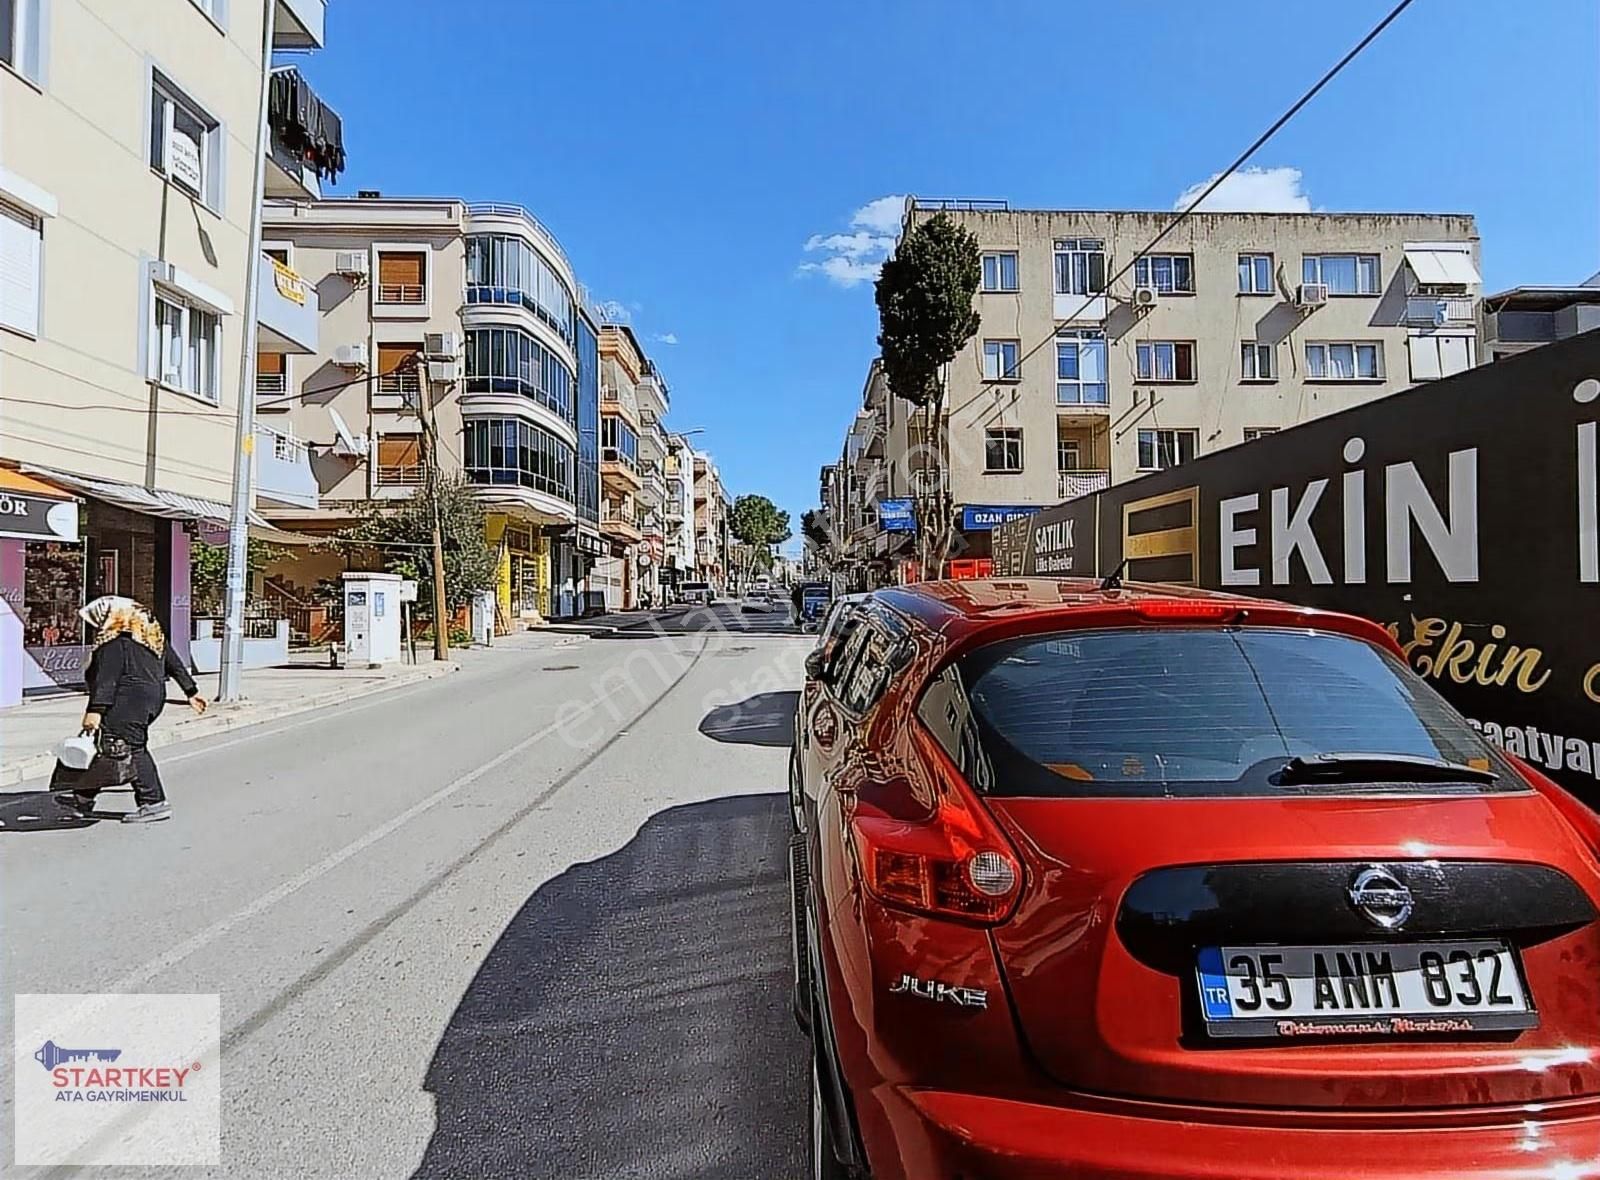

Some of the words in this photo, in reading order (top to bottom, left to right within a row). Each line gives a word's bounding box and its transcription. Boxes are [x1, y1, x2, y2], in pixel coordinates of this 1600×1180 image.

[1220, 437, 1480, 586] EKİN
[1035, 519, 1074, 553] SATILIK
[43, 648, 81, 672] Lila
[889, 975, 988, 1009] JUKE
[1206, 987, 1228, 1004] TR
[1229, 953, 1293, 1012] 35
[1313, 951, 1401, 1010] ANM
[1419, 949, 1514, 1007] 832
